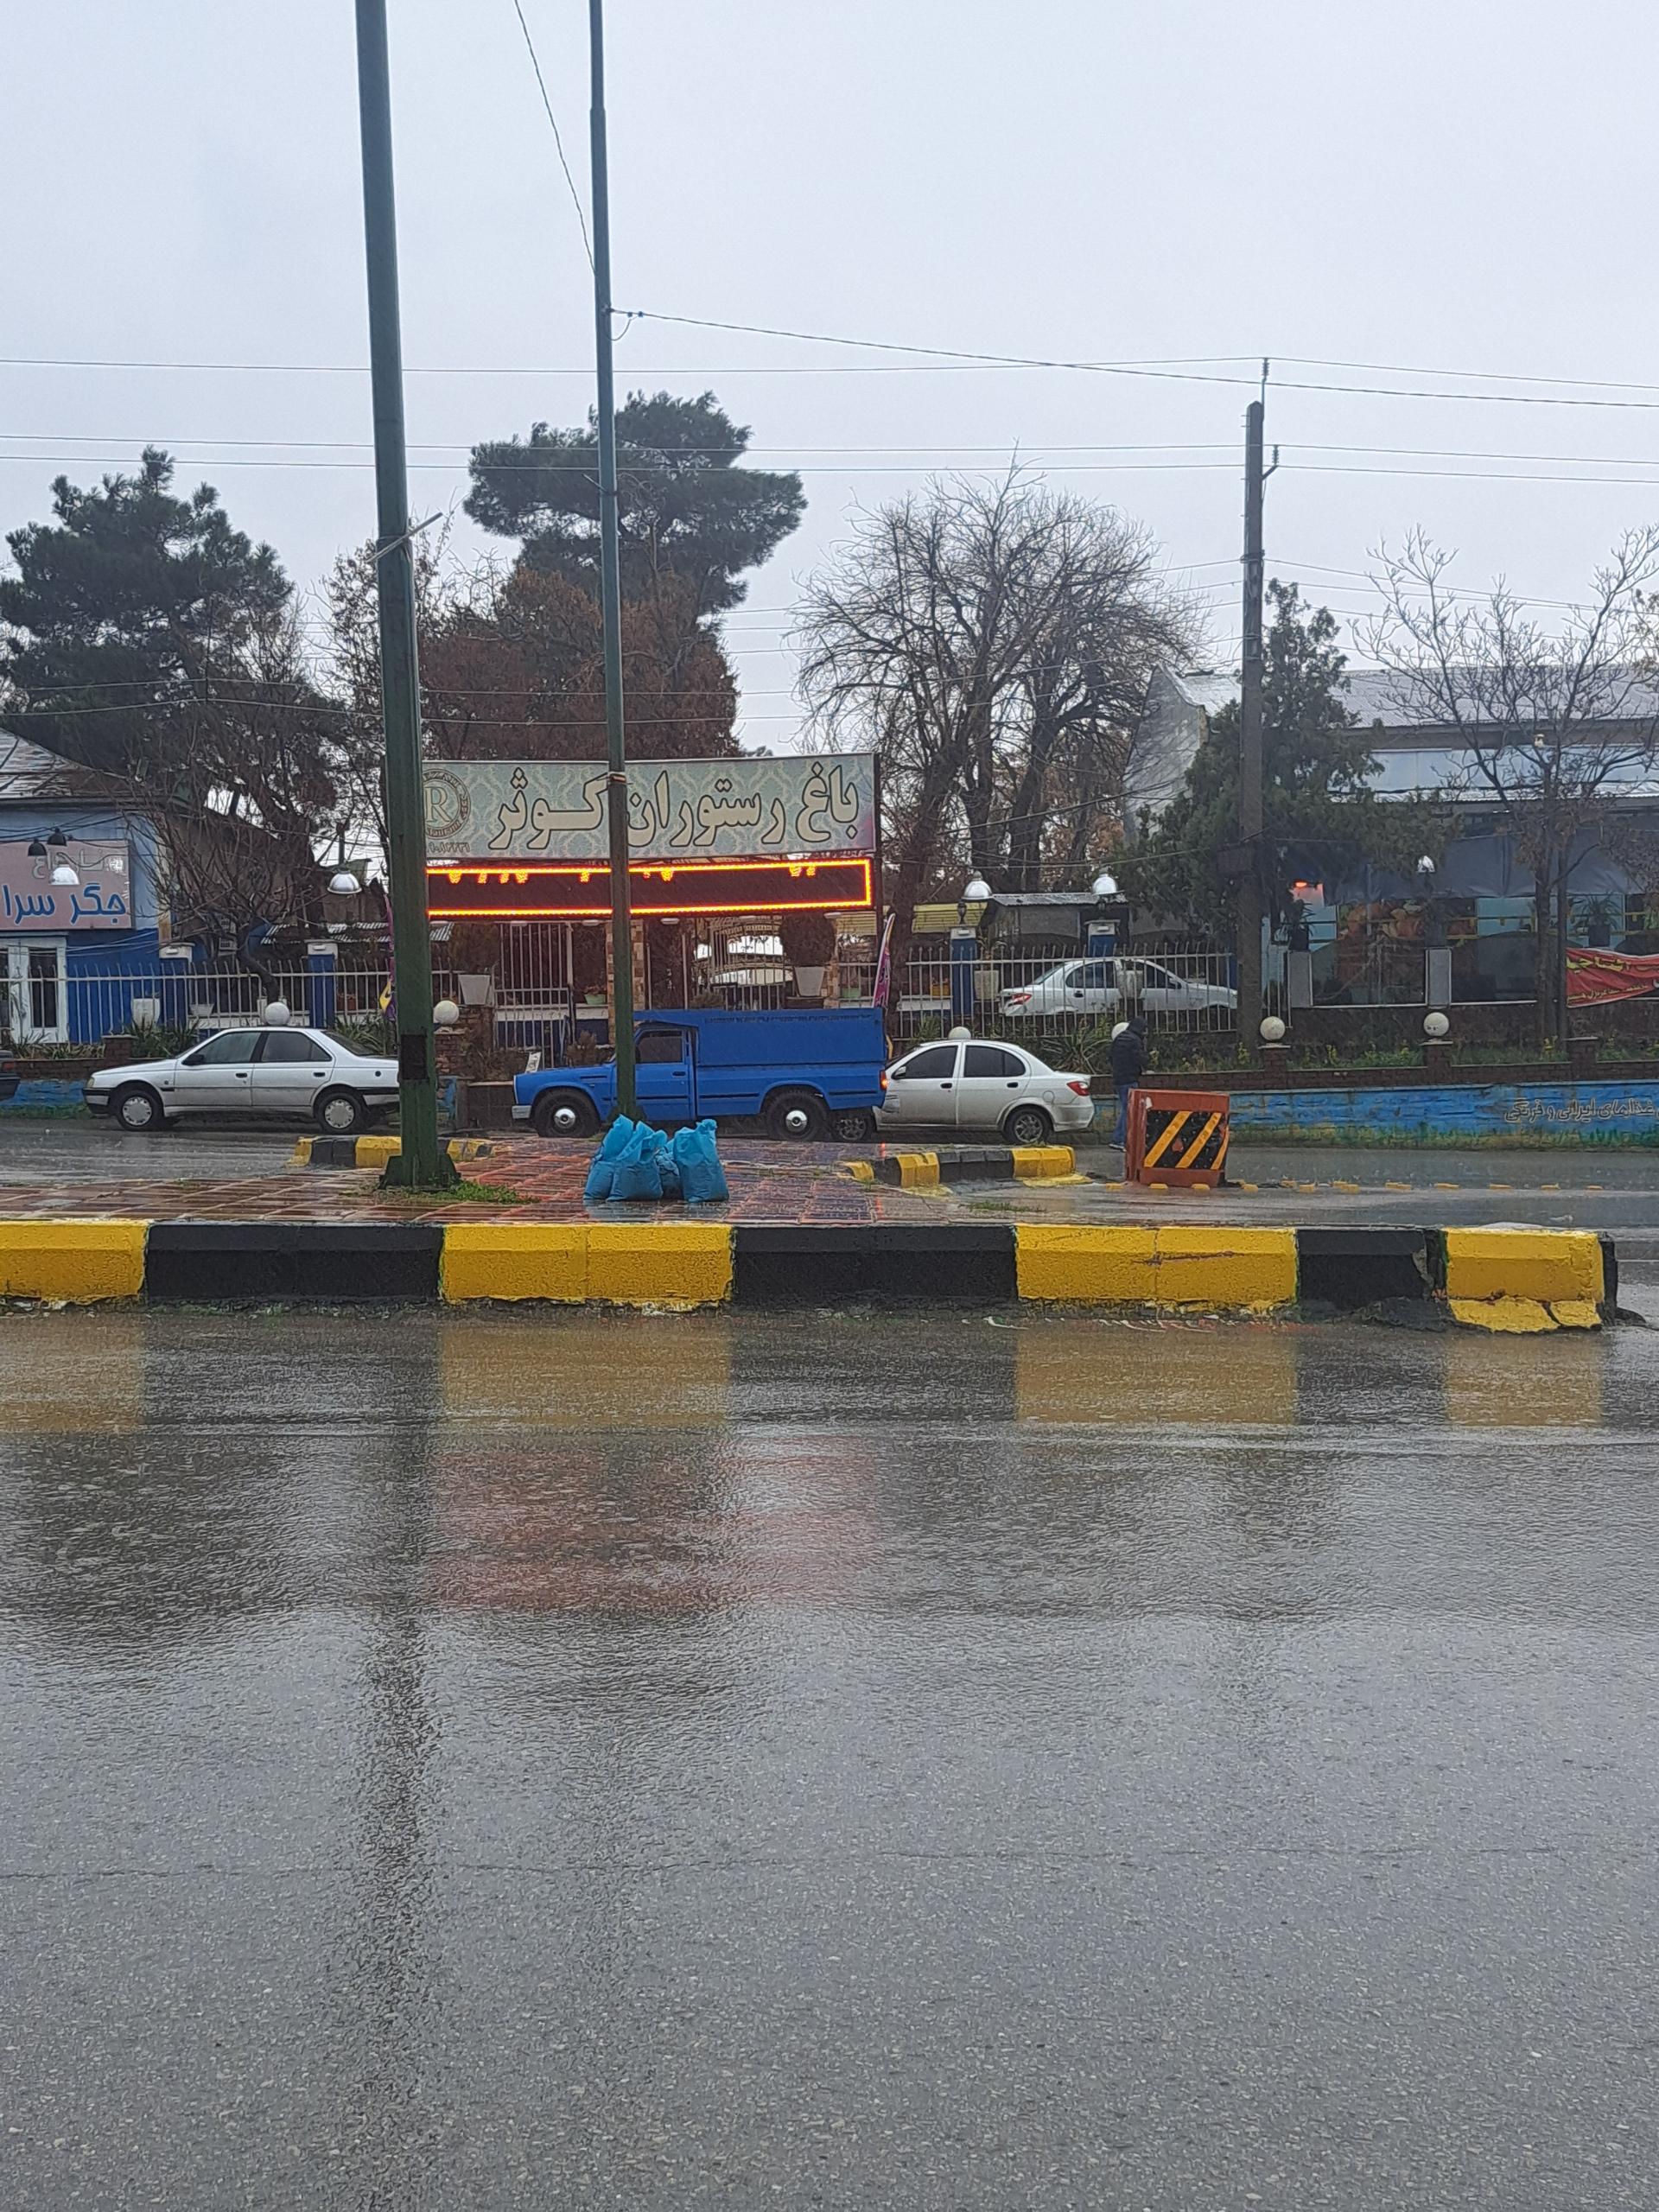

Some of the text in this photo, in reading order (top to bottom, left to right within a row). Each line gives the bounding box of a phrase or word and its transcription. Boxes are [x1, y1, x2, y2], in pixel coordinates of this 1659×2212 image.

[488, 767, 609, 849] کوثر
[626, 770, 785, 848] رستوران
[796, 761, 858, 842] باغ
[2, 882, 127, 925] جگر سرا
[1504, 1097, 1545, 1122] فرنگی
[1547, 1105, 1555, 1122] و
[1557, 1098, 1595, 1122] ایرانی
